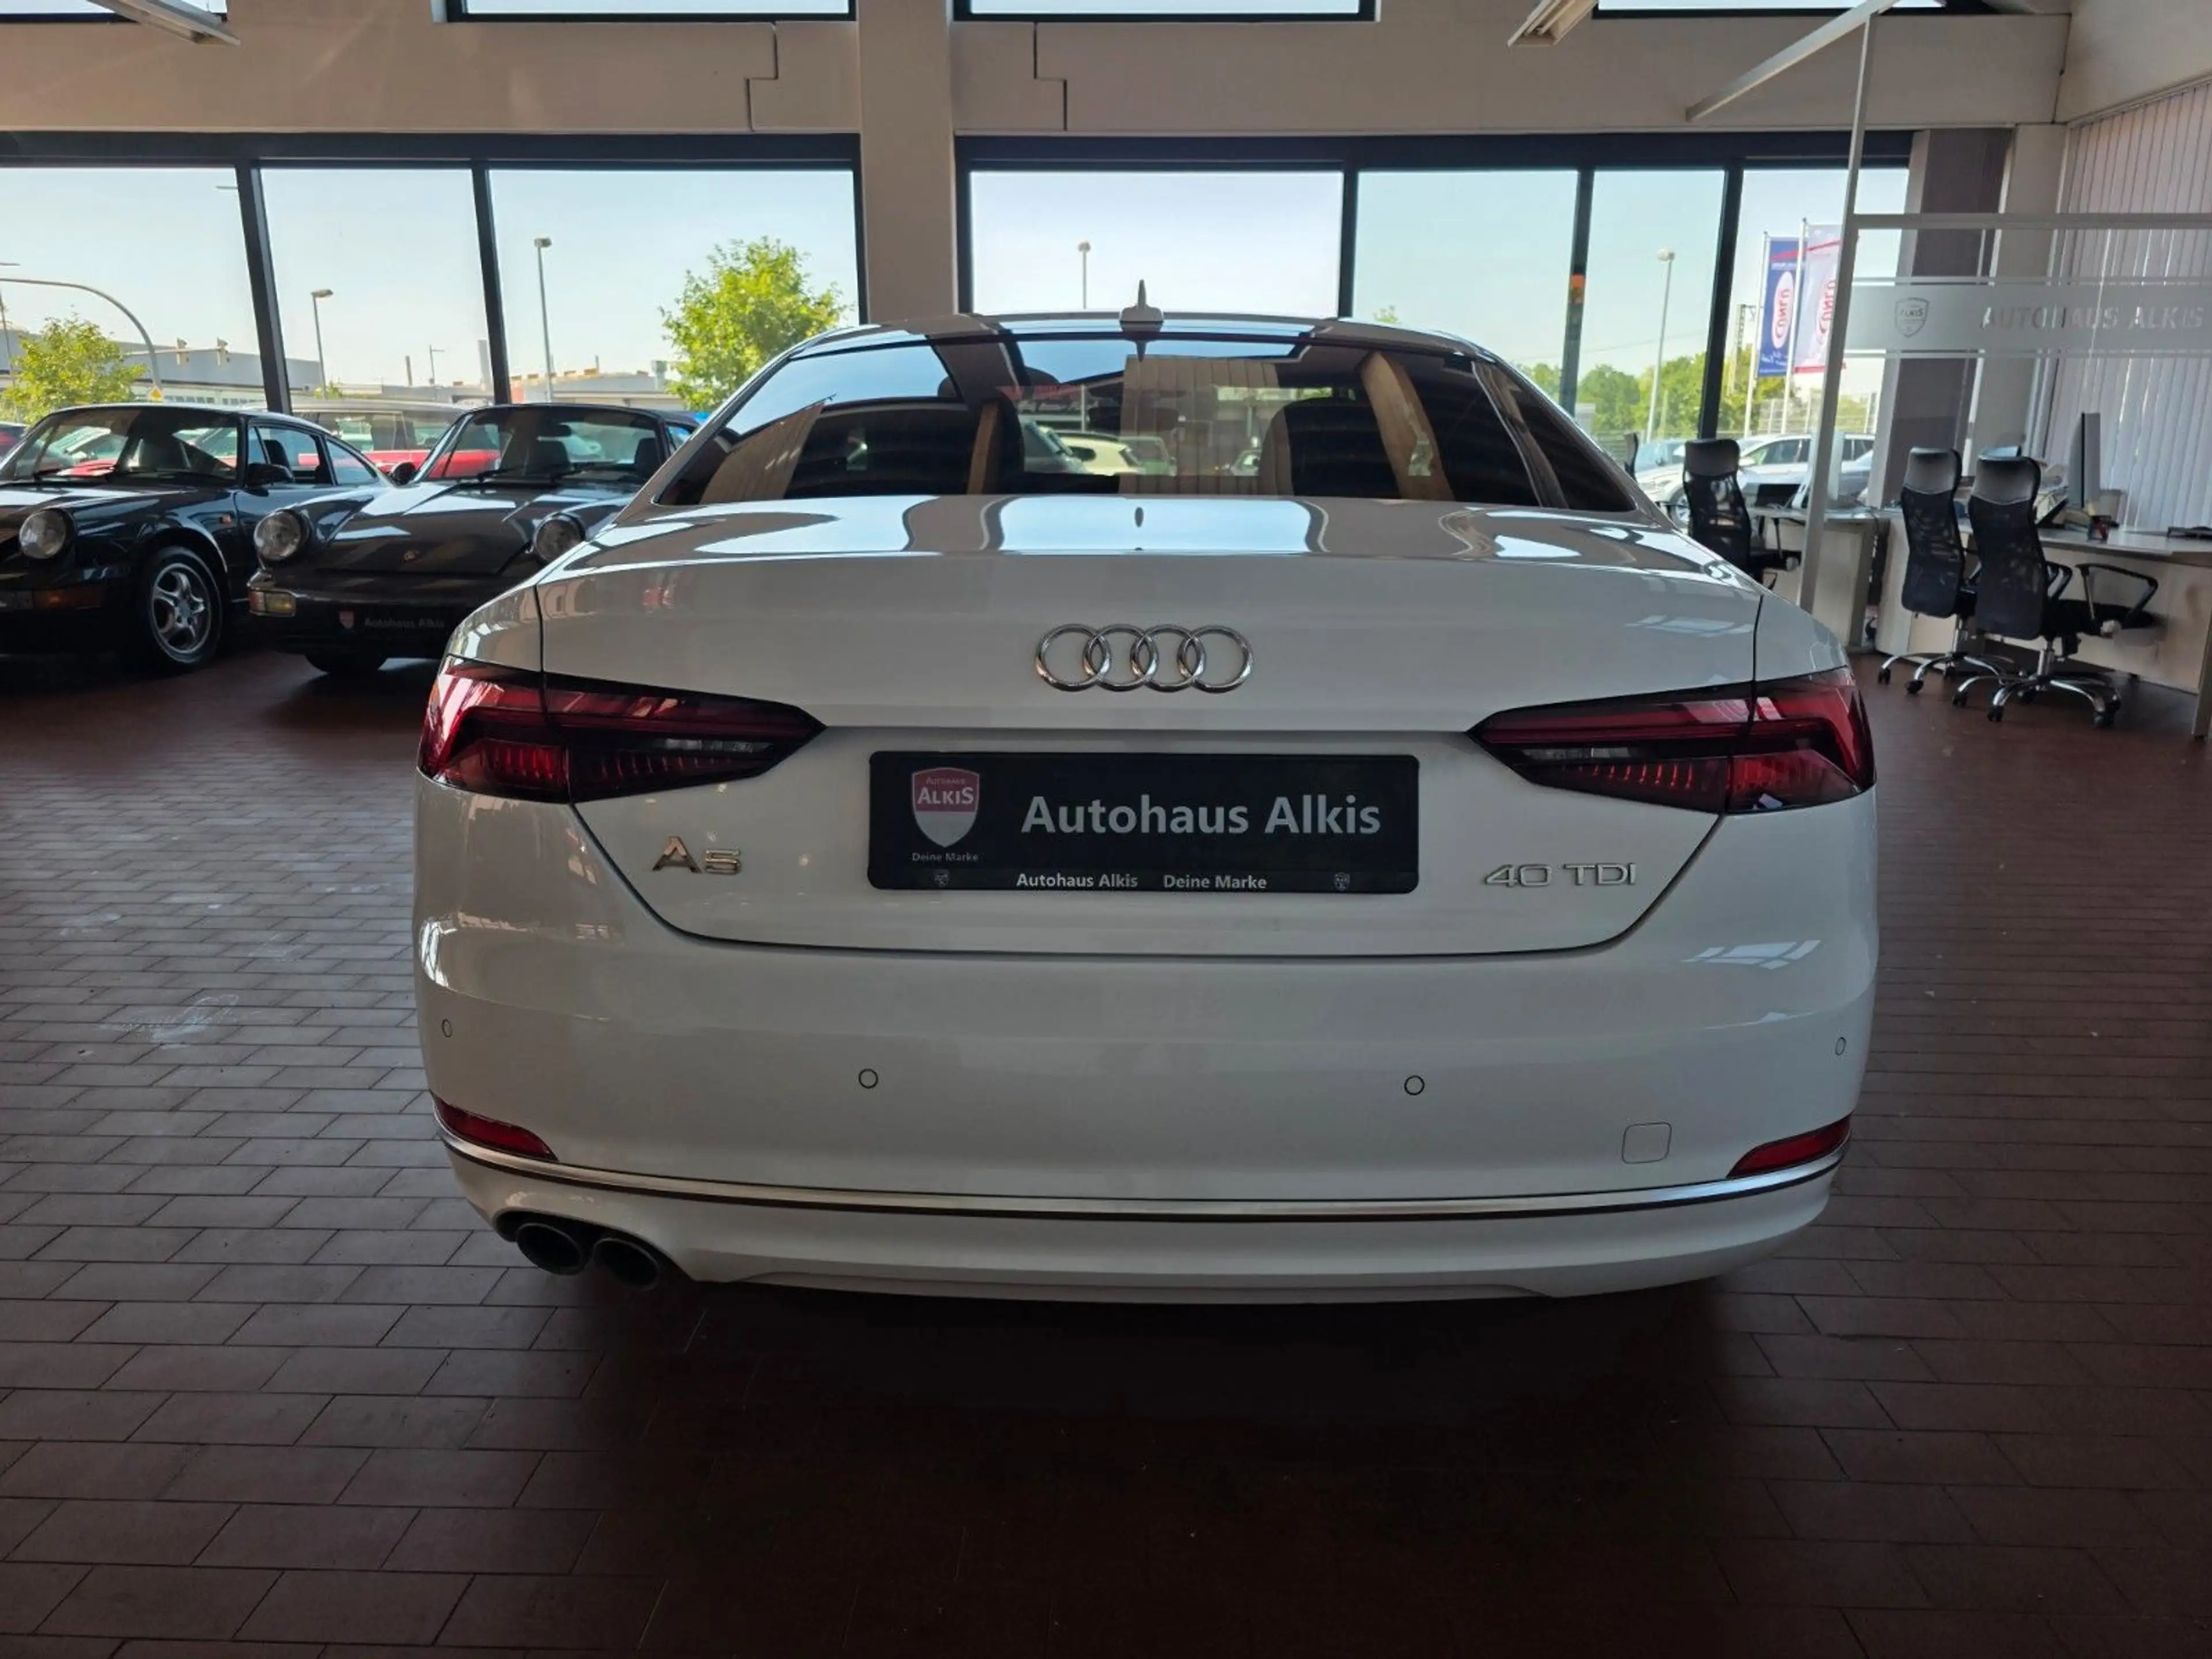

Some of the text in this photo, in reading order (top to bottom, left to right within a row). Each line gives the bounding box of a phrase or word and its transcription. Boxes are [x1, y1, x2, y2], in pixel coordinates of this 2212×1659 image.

[2127, 305, 2205, 329] ALKIS
[1021, 794, 1381, 834] Autohaus Alkis
[652, 835, 742, 876] A5
[911, 853, 979, 862] Deine Marke
[1016, 873, 1267, 889] Autohaus Alkis Deine Marke
[1483, 863, 1637, 887] 40 TDI
